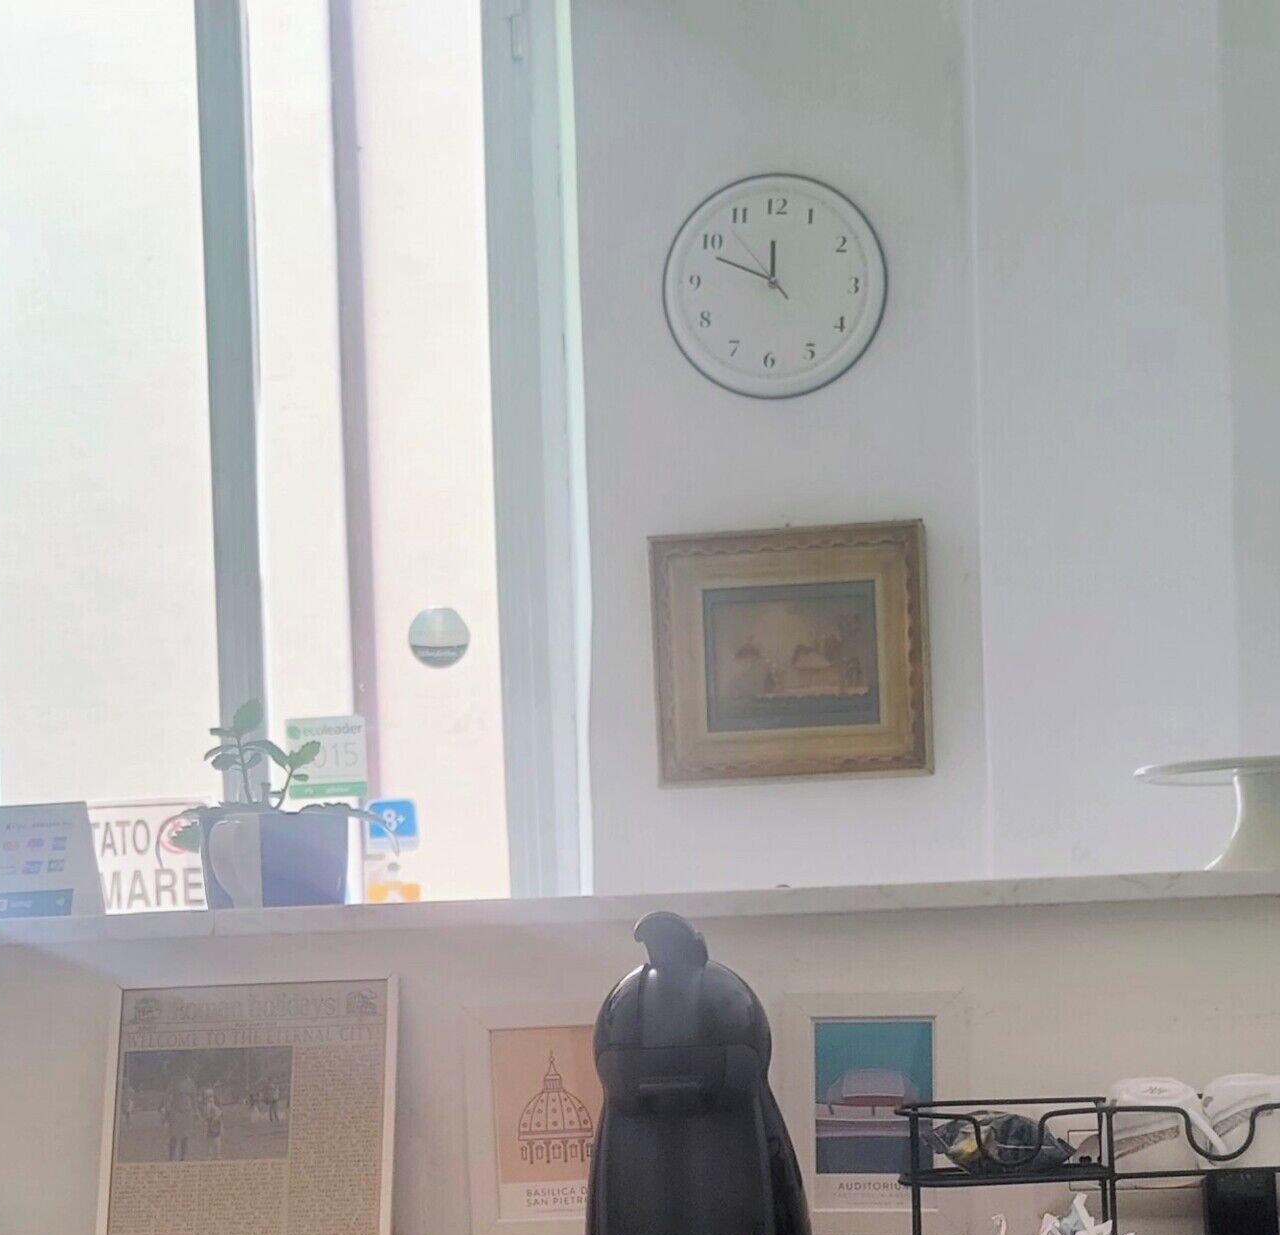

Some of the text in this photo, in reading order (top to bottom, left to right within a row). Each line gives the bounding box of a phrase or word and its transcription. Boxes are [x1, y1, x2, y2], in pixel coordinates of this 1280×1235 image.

[767, 198, 787, 215] 12
[732, 207, 748, 224] 11
[703, 233, 723, 250] 10
[835, 235, 847, 253] 2
[689, 274, 701, 290] 9
[848, 276, 860, 294] 3
[699, 311, 711, 328] 8
[833, 316, 846, 333] 4
[728, 340, 740, 357] 7
[803, 343, 816, 361] 5
[763, 352, 776, 368] 6
[127, 1031, 199, 1049] WELCOME
[207, 1030, 226, 1047] TO
[525, 1186, 576, 1199] BASILICA
[526, 1197, 549, 1207] SAN
